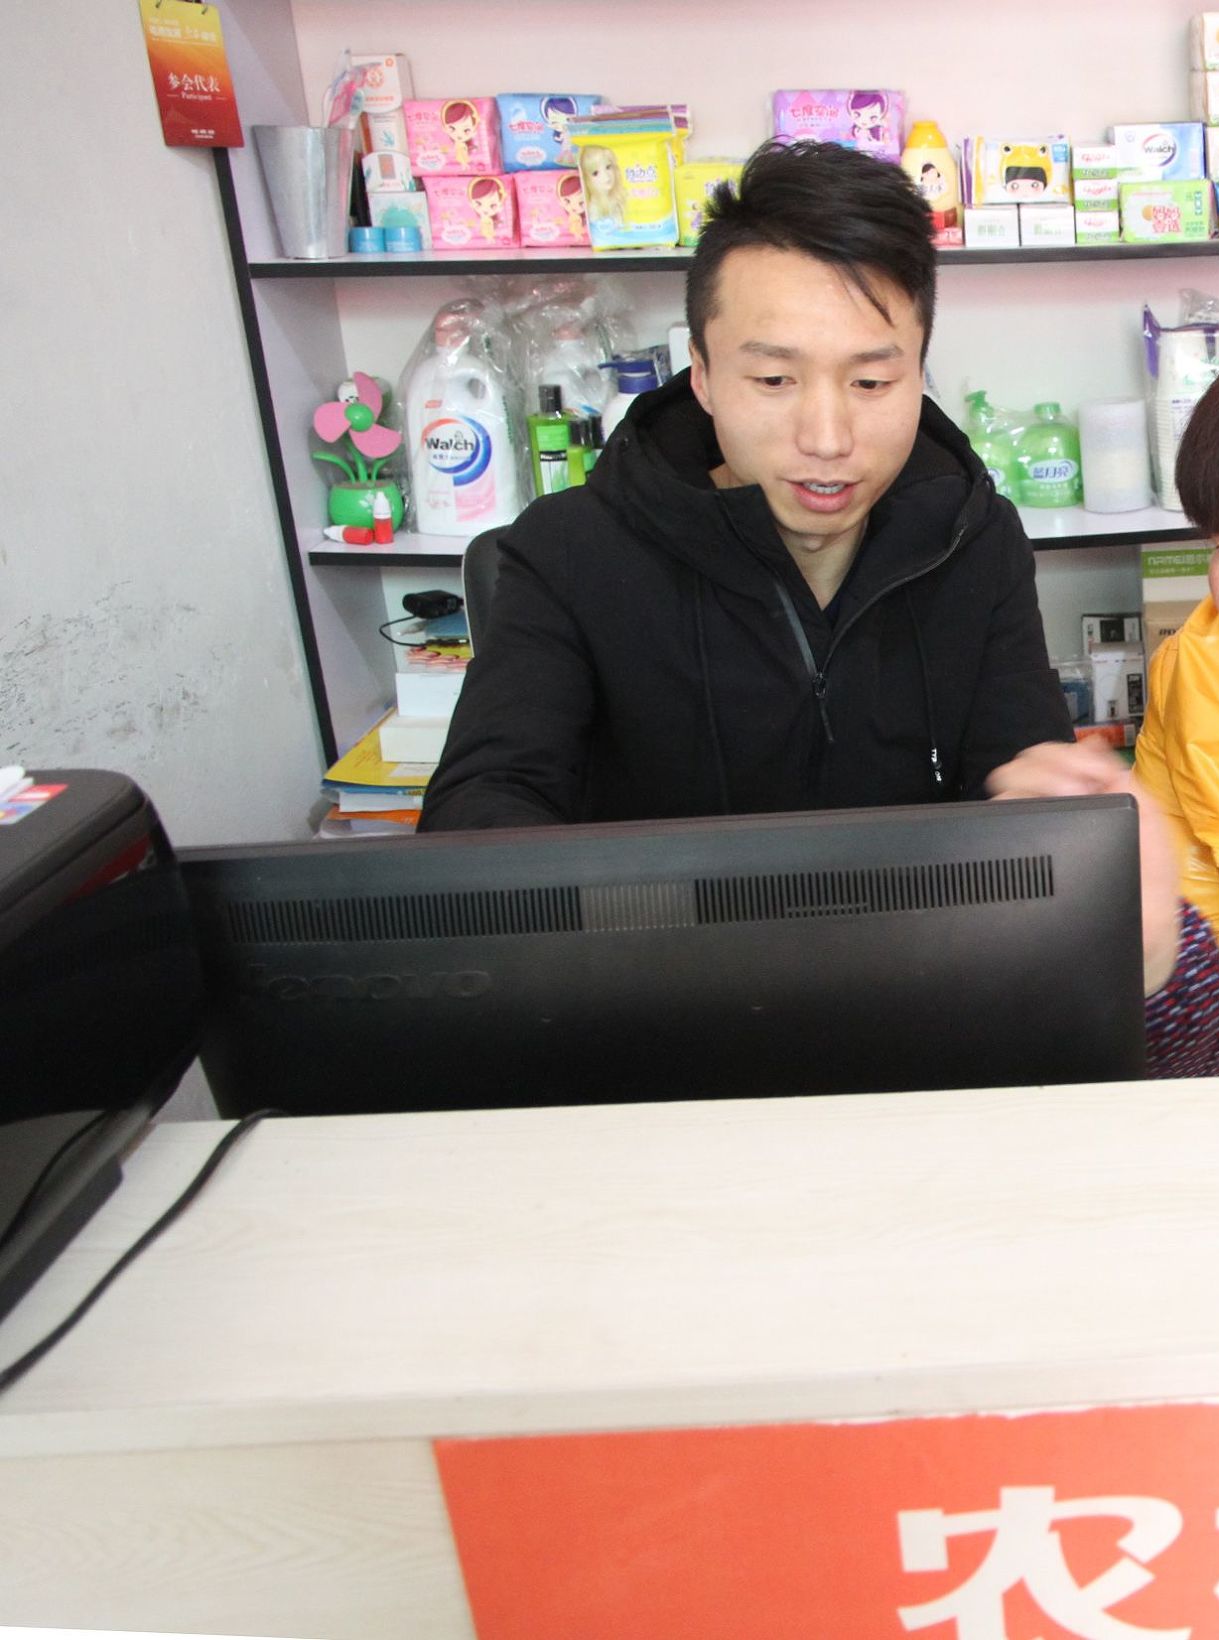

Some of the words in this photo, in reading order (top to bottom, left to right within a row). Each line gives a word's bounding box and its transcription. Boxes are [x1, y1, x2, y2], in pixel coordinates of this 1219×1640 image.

[168, 72, 221, 93] 参会代表
[425, 437, 475, 451] Walch
